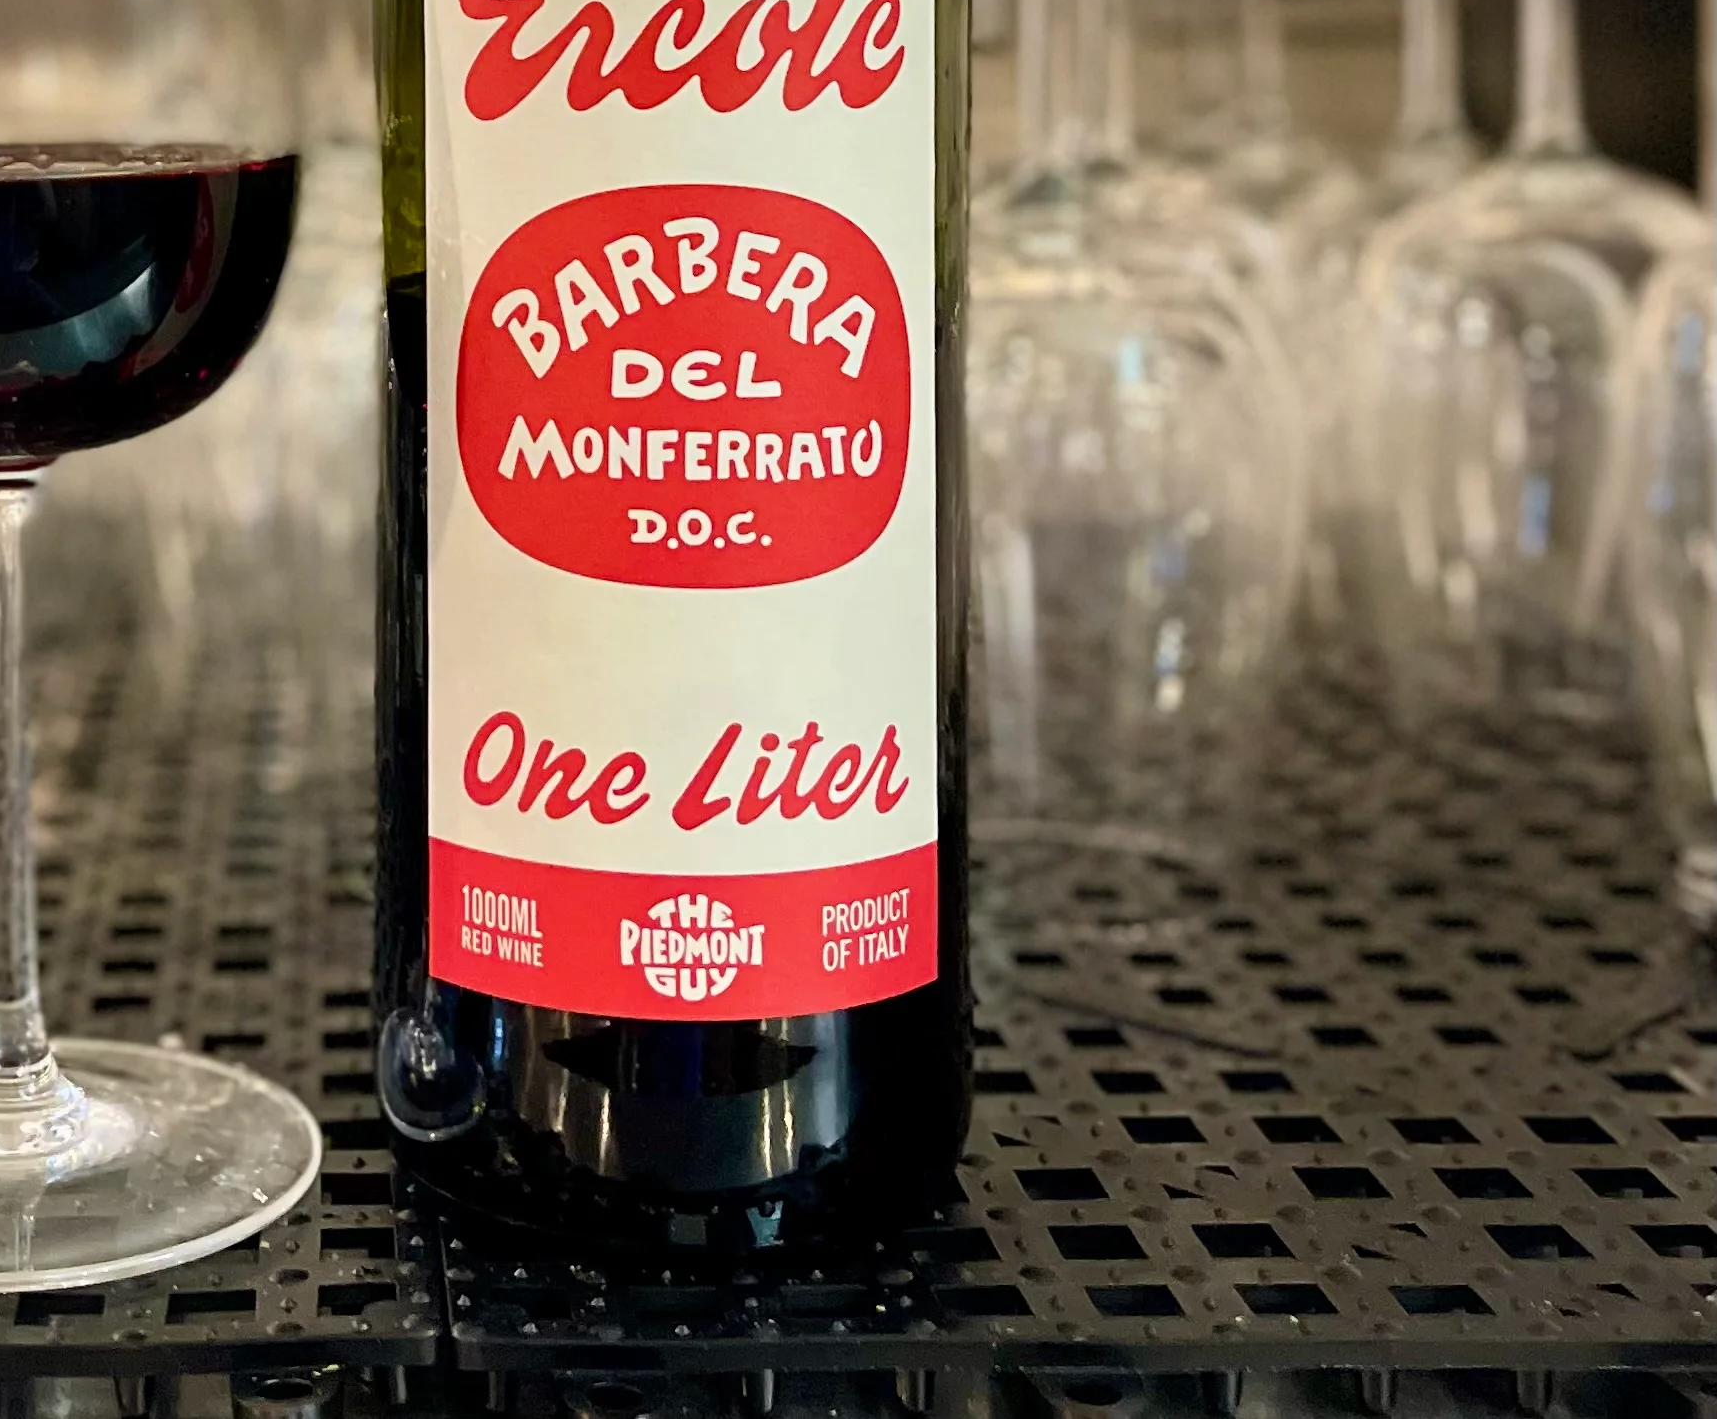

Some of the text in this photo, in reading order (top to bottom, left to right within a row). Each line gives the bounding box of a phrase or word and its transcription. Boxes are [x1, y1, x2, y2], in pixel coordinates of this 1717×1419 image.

[491, 216, 876, 379] BARBERA
[611, 349, 782, 400] DEL
[498, 415, 882, 483] MONFERRATO
[627, 509, 773, 549] D.O.C.
[464, 711, 909, 831] One Liter
[461, 884, 543, 938] 1000ML
[647, 893, 735, 929] THE
[822, 887, 910, 937] PRODUCT
[461, 925, 544, 968] RED WINE
[619, 918, 765, 966] PIEDMONT
[822, 923, 909, 972] OF ITALY
[643, 966, 739, 1002] GUY
